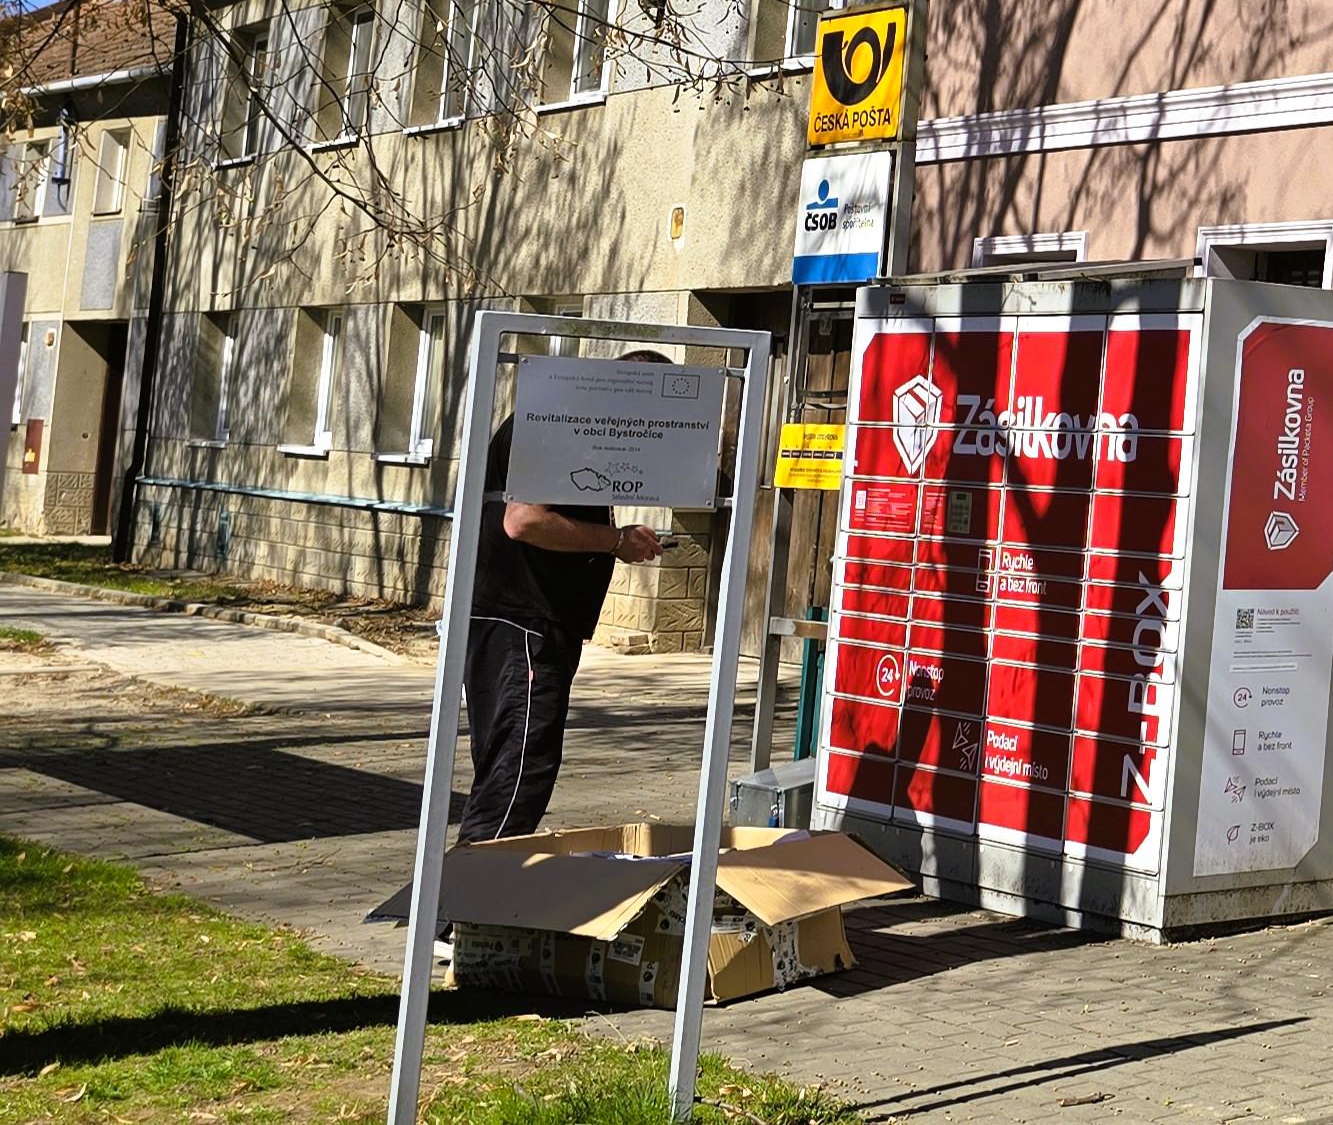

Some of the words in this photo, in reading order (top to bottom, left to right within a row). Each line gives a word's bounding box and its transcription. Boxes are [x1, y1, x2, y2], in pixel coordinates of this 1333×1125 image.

[813, 109, 849, 133] ČESKÁ
[851, 106, 891, 129] POŠTA
[804, 212, 838, 232] ČSOB
[1304, 395, 1315, 422] Group
[526, 412, 592, 425] Revitalizace
[594, 416, 646, 429] veřejných
[647, 418, 710, 431] prostranství
[953, 394, 1139, 463] Zásilkovna
[573, 428, 580, 436] v
[608, 427, 664, 440] Bystročice
[1273, 368, 1305, 501] Zásilkovna
[612, 480, 644, 493] ROP
[1002, 551, 1034, 572] Rychle
[999, 578, 1007, 592] a
[1007, 575, 1025, 593] bez
[881, 668, 894, 683] 24
[909, 660, 945, 683] Nonstop
[907, 685, 936, 701] provoz
[1121, 571, 1168, 805] Z-BOX
[1237, 693, 1248, 702] 24
[1262, 686, 1290, 696] Nonstop
[1260, 698, 1284, 708] provoz
[986, 730, 1018, 752] Podací
[1258, 731, 1282, 741] Rychle
[988, 755, 1023, 777] výdejní
[1022, 761, 1049, 780] místo
